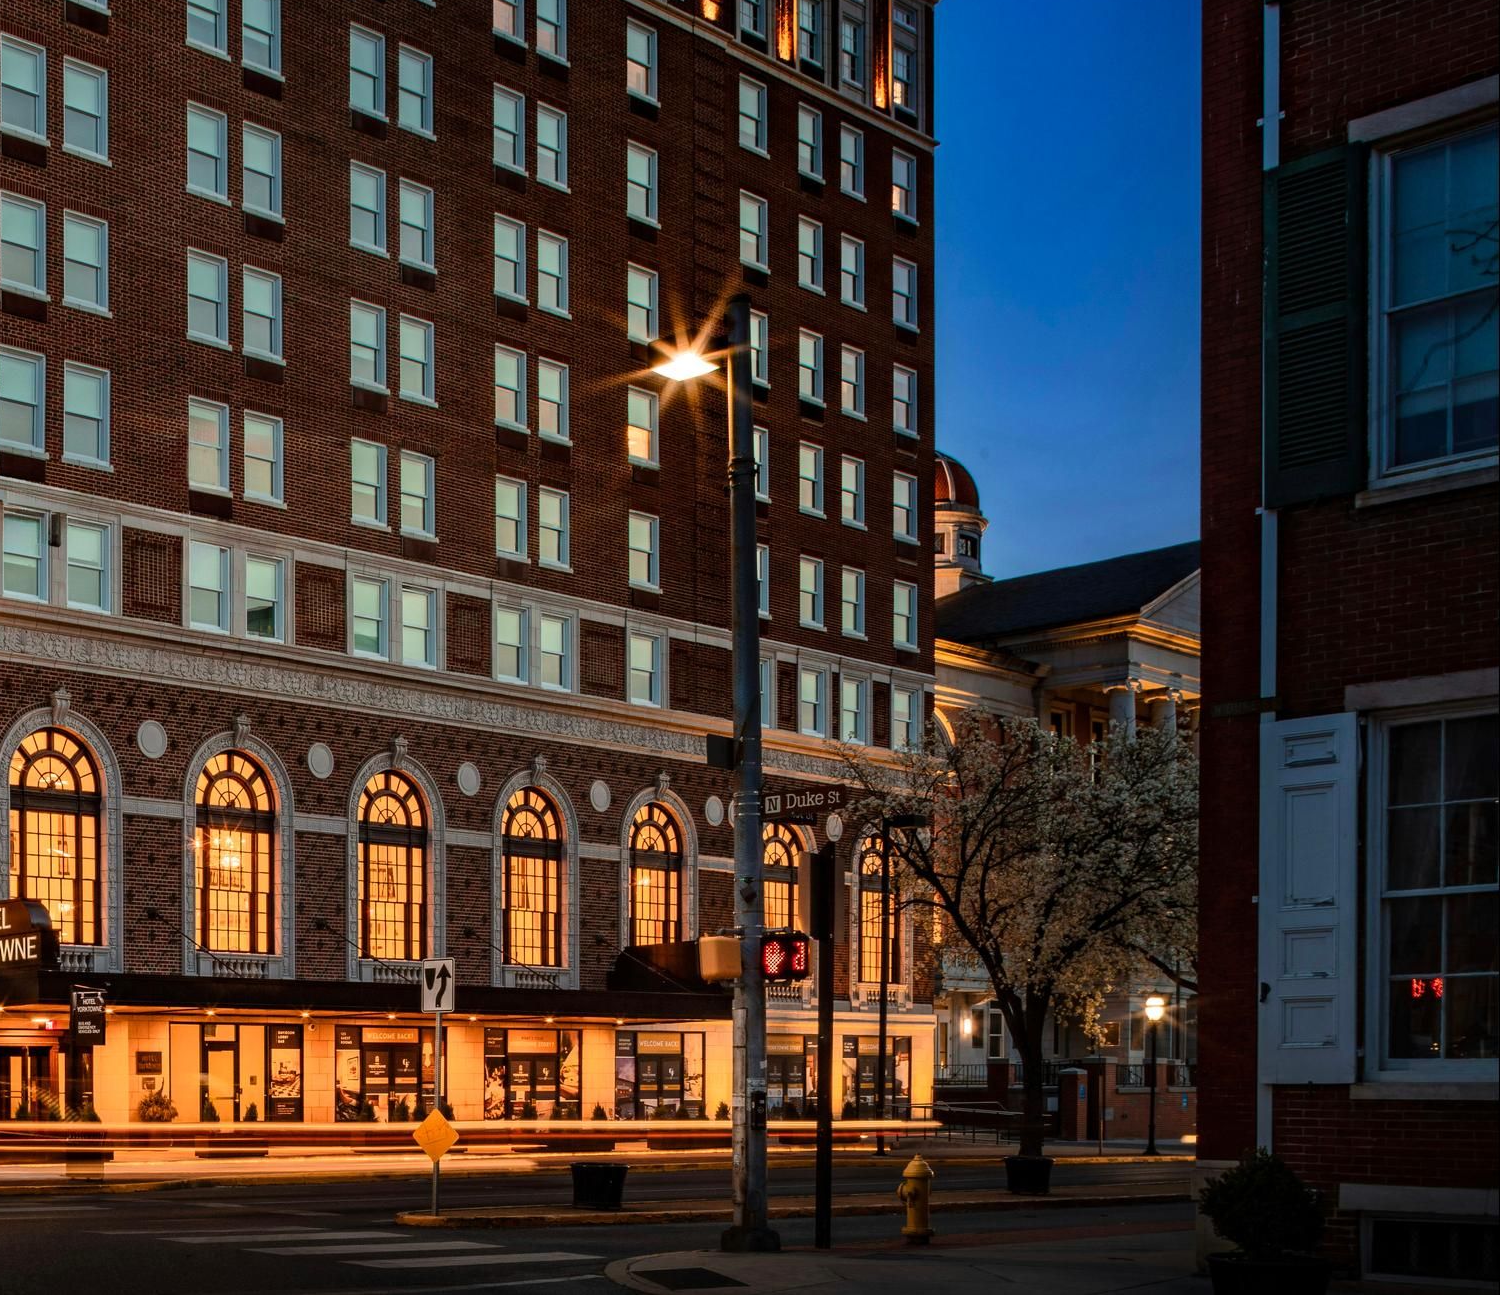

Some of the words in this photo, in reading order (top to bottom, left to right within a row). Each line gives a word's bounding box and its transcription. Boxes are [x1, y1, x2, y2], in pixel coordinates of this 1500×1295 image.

[766, 797, 779, 812] N
[785, 792, 824, 809] Duke
[827, 791, 841, 804] St
[367, 1032, 395, 1040] WELCOME
